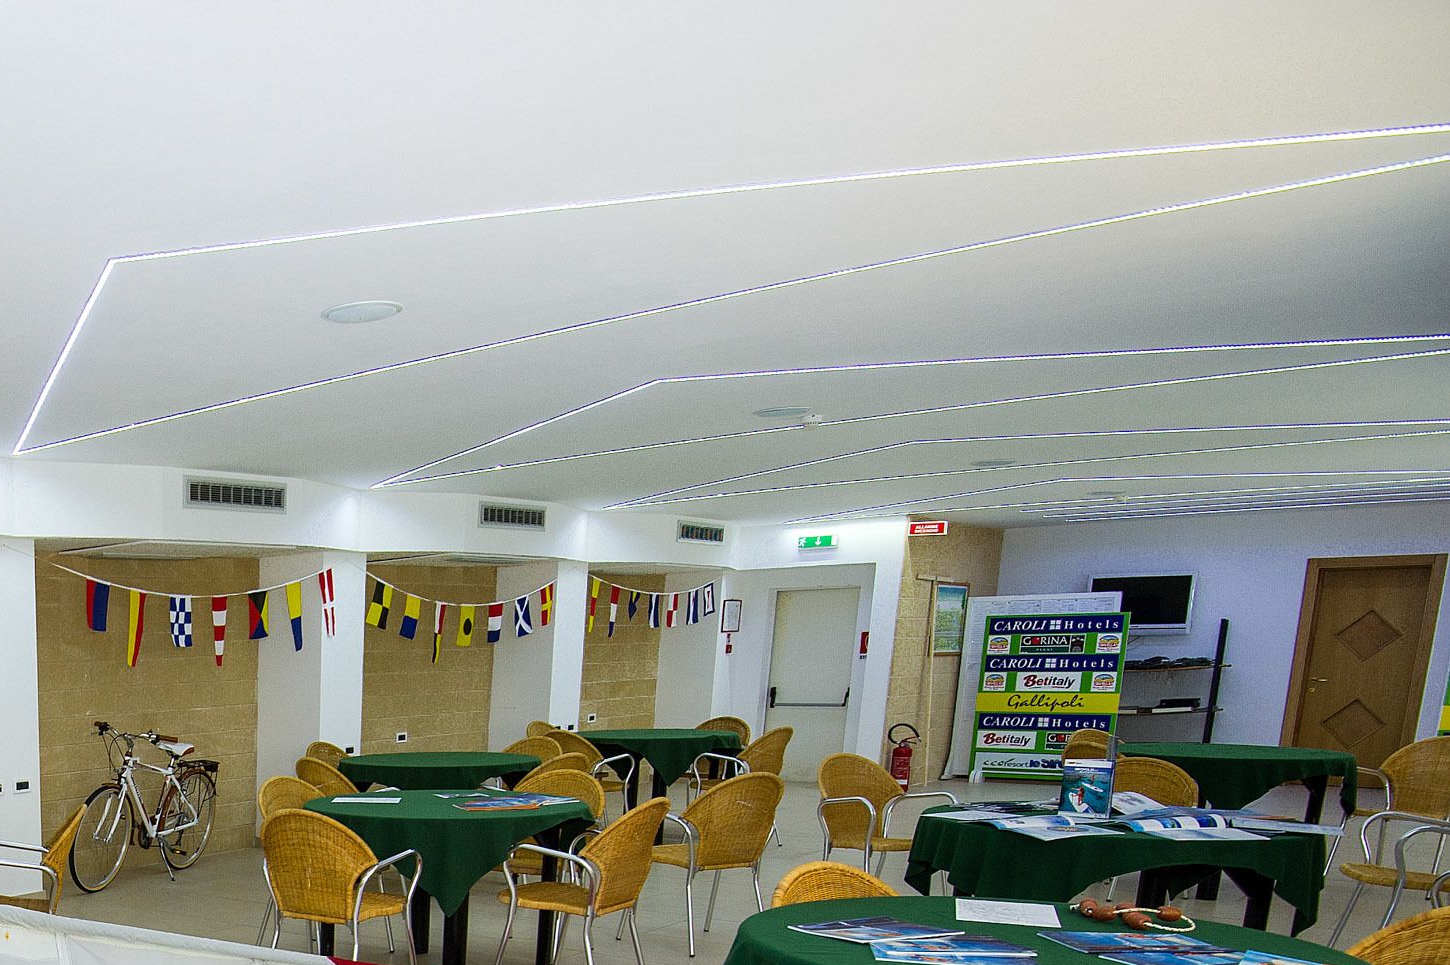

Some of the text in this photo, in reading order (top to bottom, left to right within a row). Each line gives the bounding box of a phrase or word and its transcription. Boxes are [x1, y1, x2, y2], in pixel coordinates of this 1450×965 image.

[994, 619, 1119, 631] CAROLI Hotels
[989, 657, 1114, 669] CAROLI Hotels
[1023, 674, 1076, 688] Betitaly
[1007, 694, 1085, 711] Gallipoli
[982, 716, 1106, 728] CAROLI Hotels
[983, 732, 1031, 746] Betitaly
